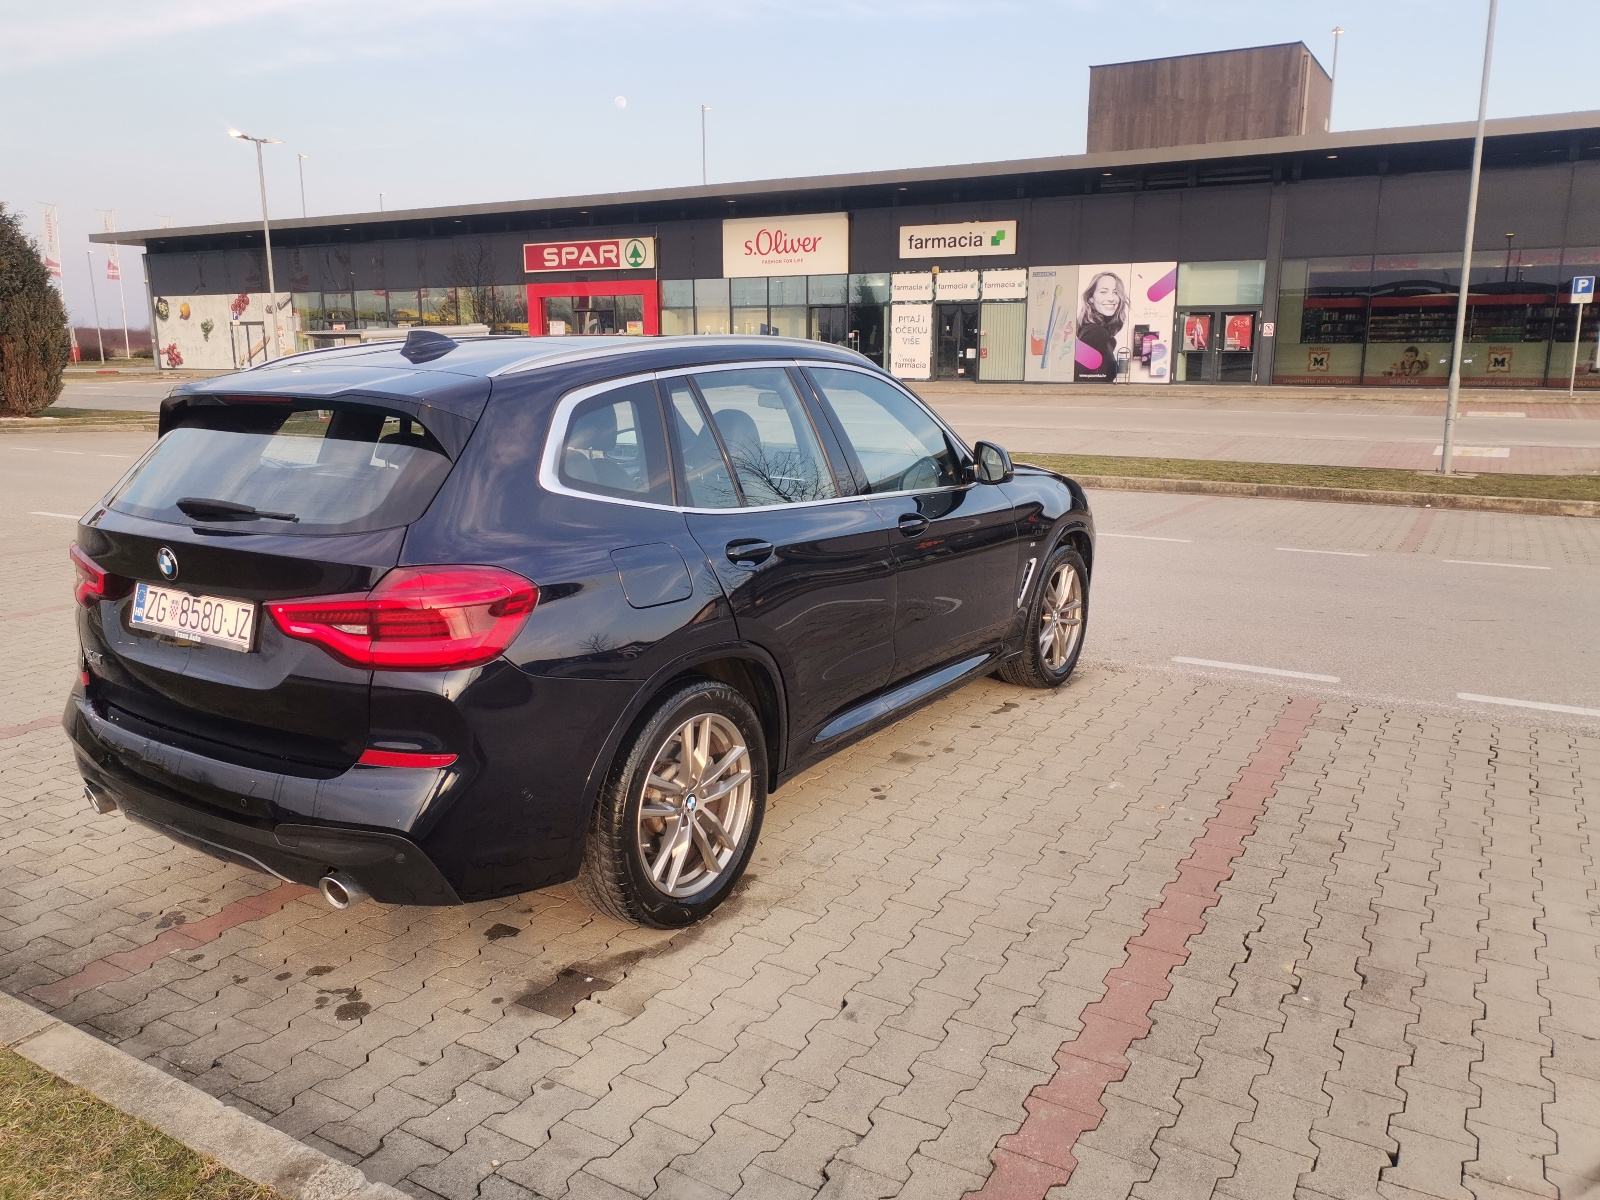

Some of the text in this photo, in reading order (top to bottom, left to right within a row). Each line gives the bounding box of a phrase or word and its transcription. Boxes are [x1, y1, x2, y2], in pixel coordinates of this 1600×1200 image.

[744, 228, 822, 256] s.Oliver
[908, 231, 983, 250] farmacia
[543, 244, 618, 267] SPAR
[938, 282, 968, 290] farmacia
[984, 281, 1015, 289] farmacia
[1577, 279, 1589, 292] P
[898, 315, 920, 323] PITAJ
[902, 336, 921, 345] VIŠE
[894, 361, 927, 369] farmacia
[1312, 357, 1325, 366] M
[1492, 357, 1506, 367] M
[145, 590, 168, 623] ZG
